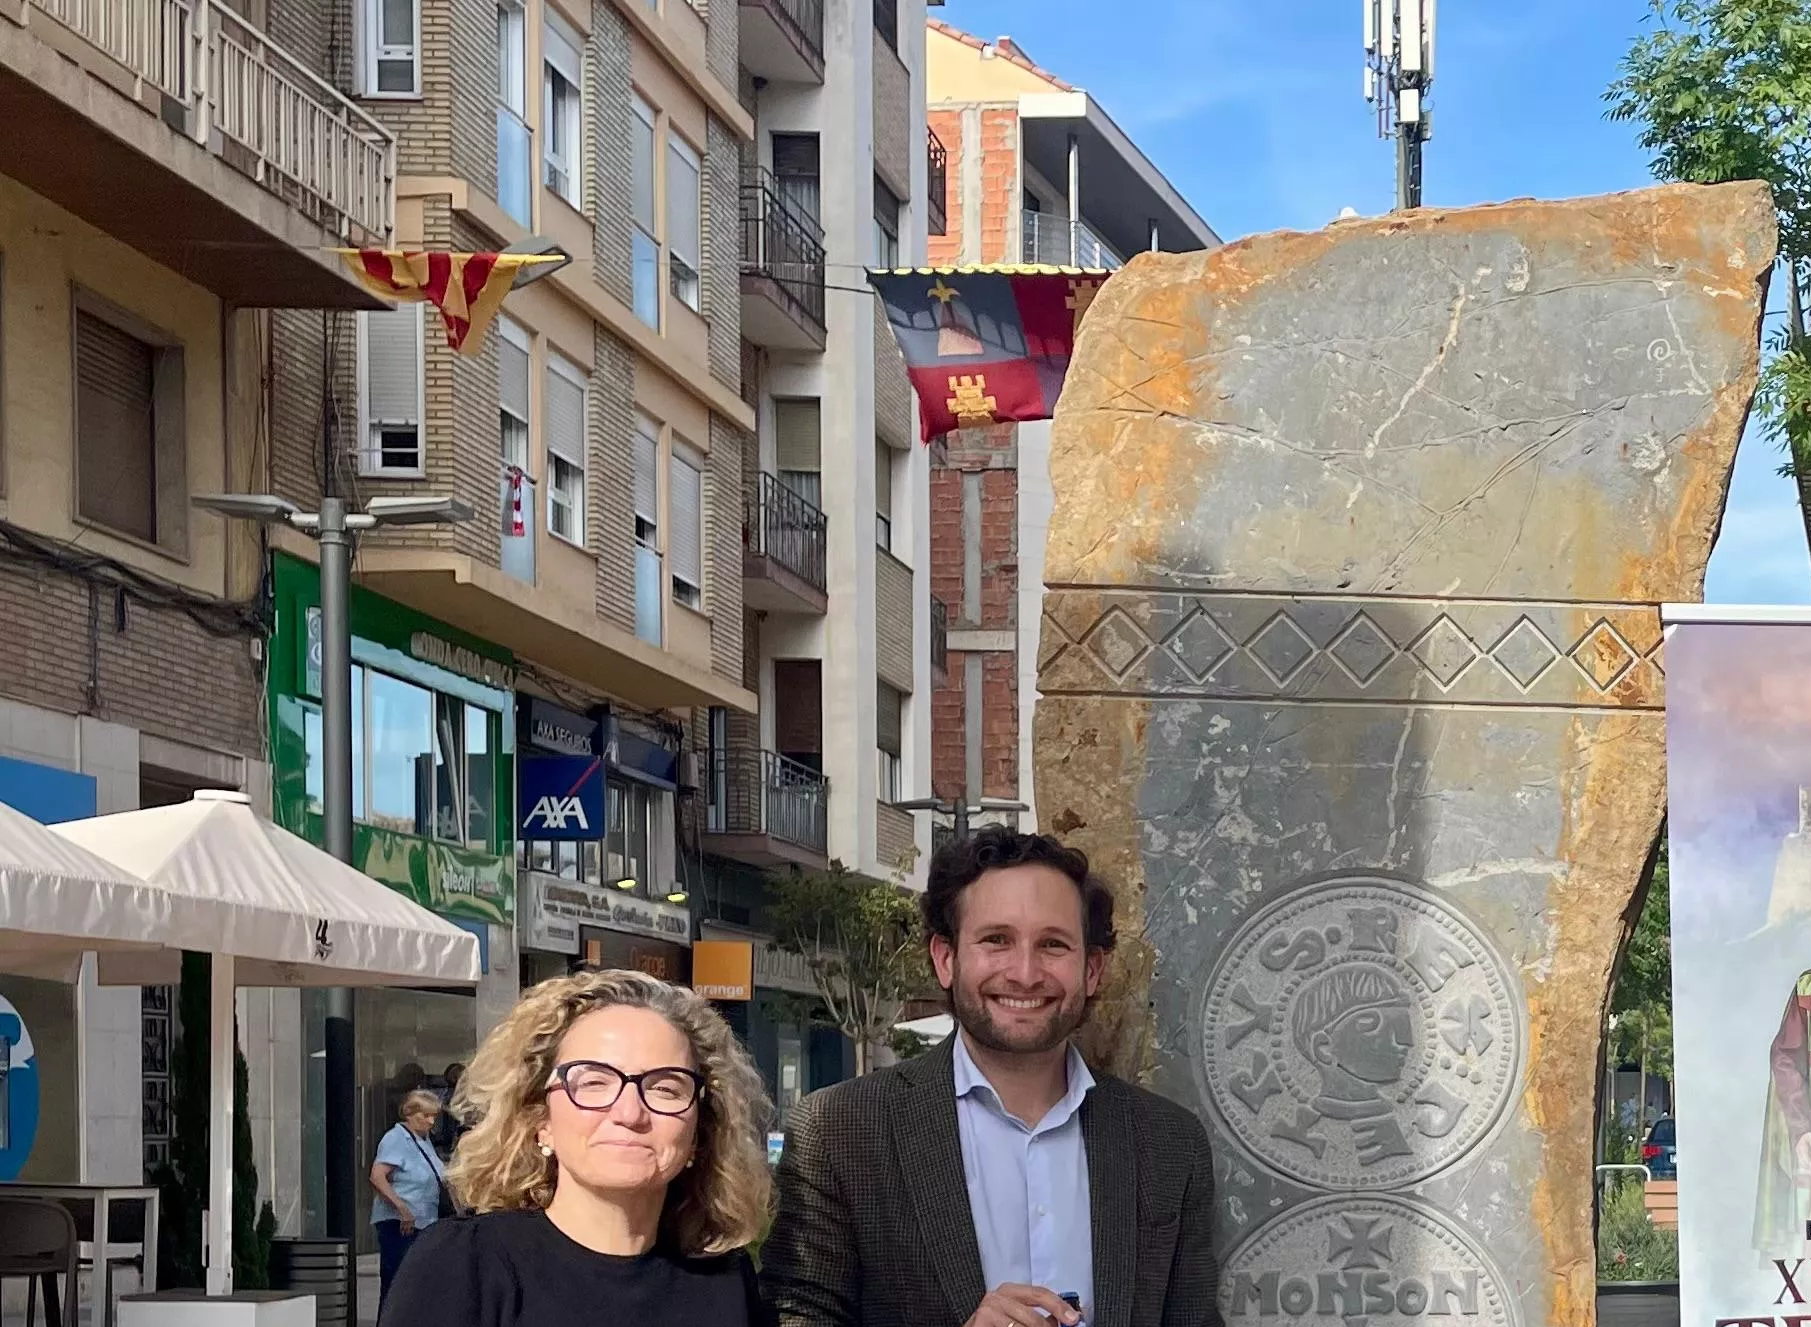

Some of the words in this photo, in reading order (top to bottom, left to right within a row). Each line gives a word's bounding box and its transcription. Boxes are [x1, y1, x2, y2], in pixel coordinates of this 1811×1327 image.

[537, 719, 554, 740] AXA
[523, 796, 589, 830] AXA
[695, 984, 744, 998] orange
